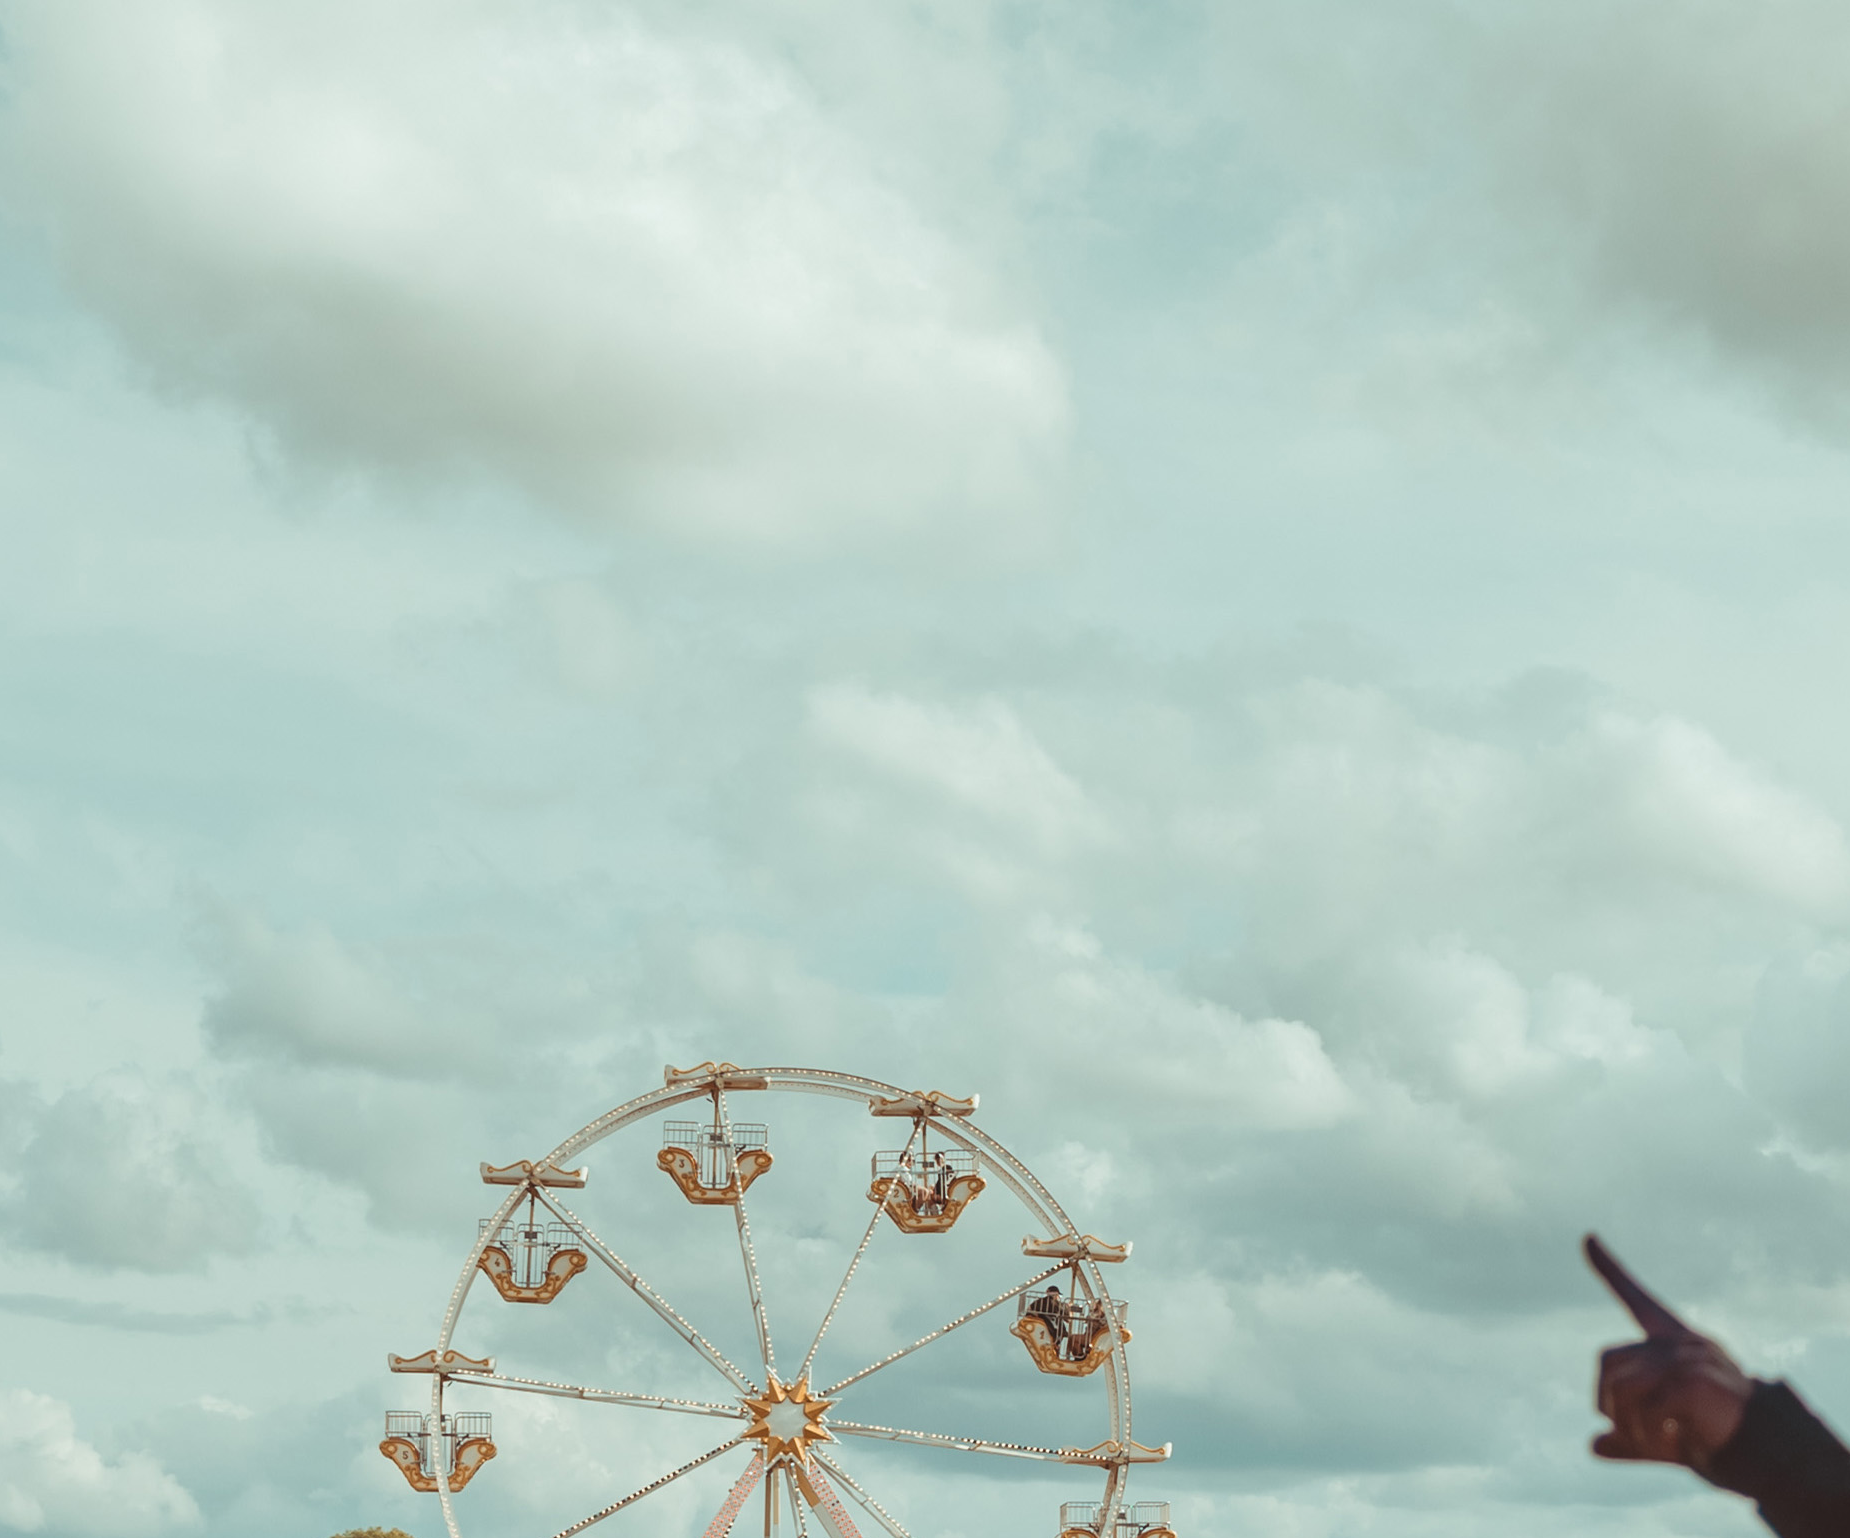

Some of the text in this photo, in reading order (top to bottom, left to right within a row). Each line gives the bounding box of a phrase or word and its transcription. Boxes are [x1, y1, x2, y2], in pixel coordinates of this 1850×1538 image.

[678, 1158, 685, 1169] 3
[893, 1187, 901, 1198] 2
[1039, 1330, 1046, 1340] 1
[402, 1450, 410, 1460] 5
